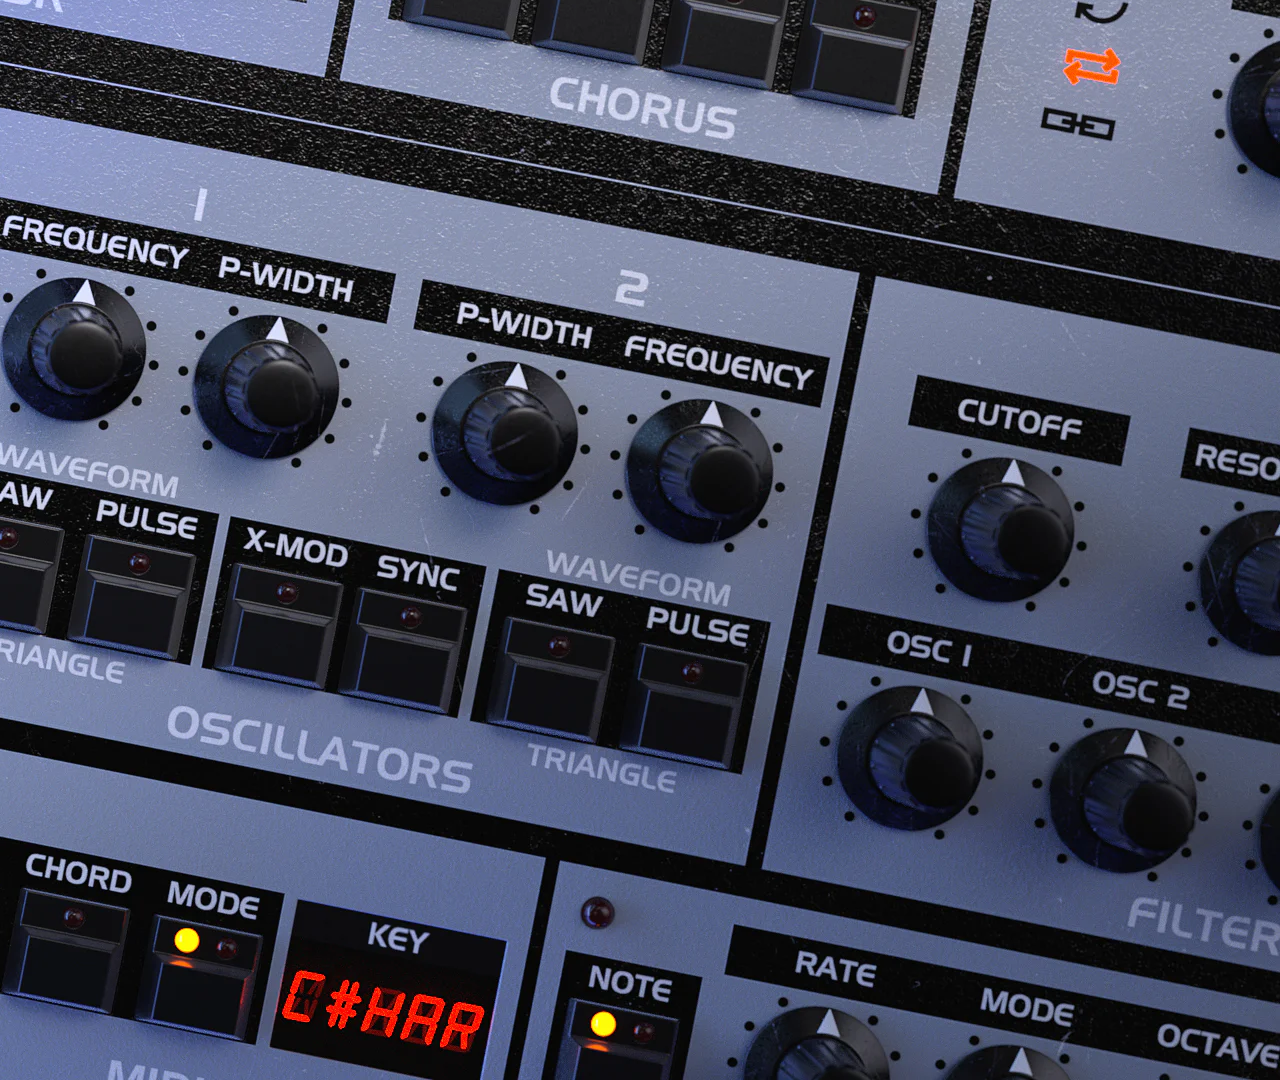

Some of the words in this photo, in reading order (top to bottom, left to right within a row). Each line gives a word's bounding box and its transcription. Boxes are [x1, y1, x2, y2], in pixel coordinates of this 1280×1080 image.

[549, 76, 738, 140] CHORUS
[193, 187, 208, 222] 1
[1, 214, 190, 270] FREQUENCY
[218, 255, 355, 303] P-WIDTH
[614, 269, 650, 307] 2
[456, 301, 593, 349] P-WIDTH
[624, 335, 815, 391] FREQUENCY
[957, 398, 1083, 441] CUTOFF
[1195, 443, 1280, 481] RESO
[95, 499, 199, 540] PULSE
[243, 526, 349, 568] X-MOD
[376, 554, 461, 592] SYNC
[545, 550, 733, 608] WAVEFORM
[525, 583, 604, 618] SAW
[646, 606, 750, 648] PULSE
[886, 630, 953, 664] OSC
[962, 644, 972, 668] 1
[1092, 670, 1159, 704] OSC
[1166, 684, 1191, 711] 2
[167, 704, 476, 794] OSCILLATORS
[527, 743, 678, 794] TRIANGLE
[25, 853, 133, 894] CHORD
[167, 880, 260, 920] MODE
[367, 921, 430, 955] KEY
[1127, 896, 1280, 957] FILTER
[588, 964, 673, 1003] NOTE
[794, 950, 877, 988] RATE
[980, 987, 1075, 1028] MODE
[1157, 1023, 1280, 1069] OCTAVE
